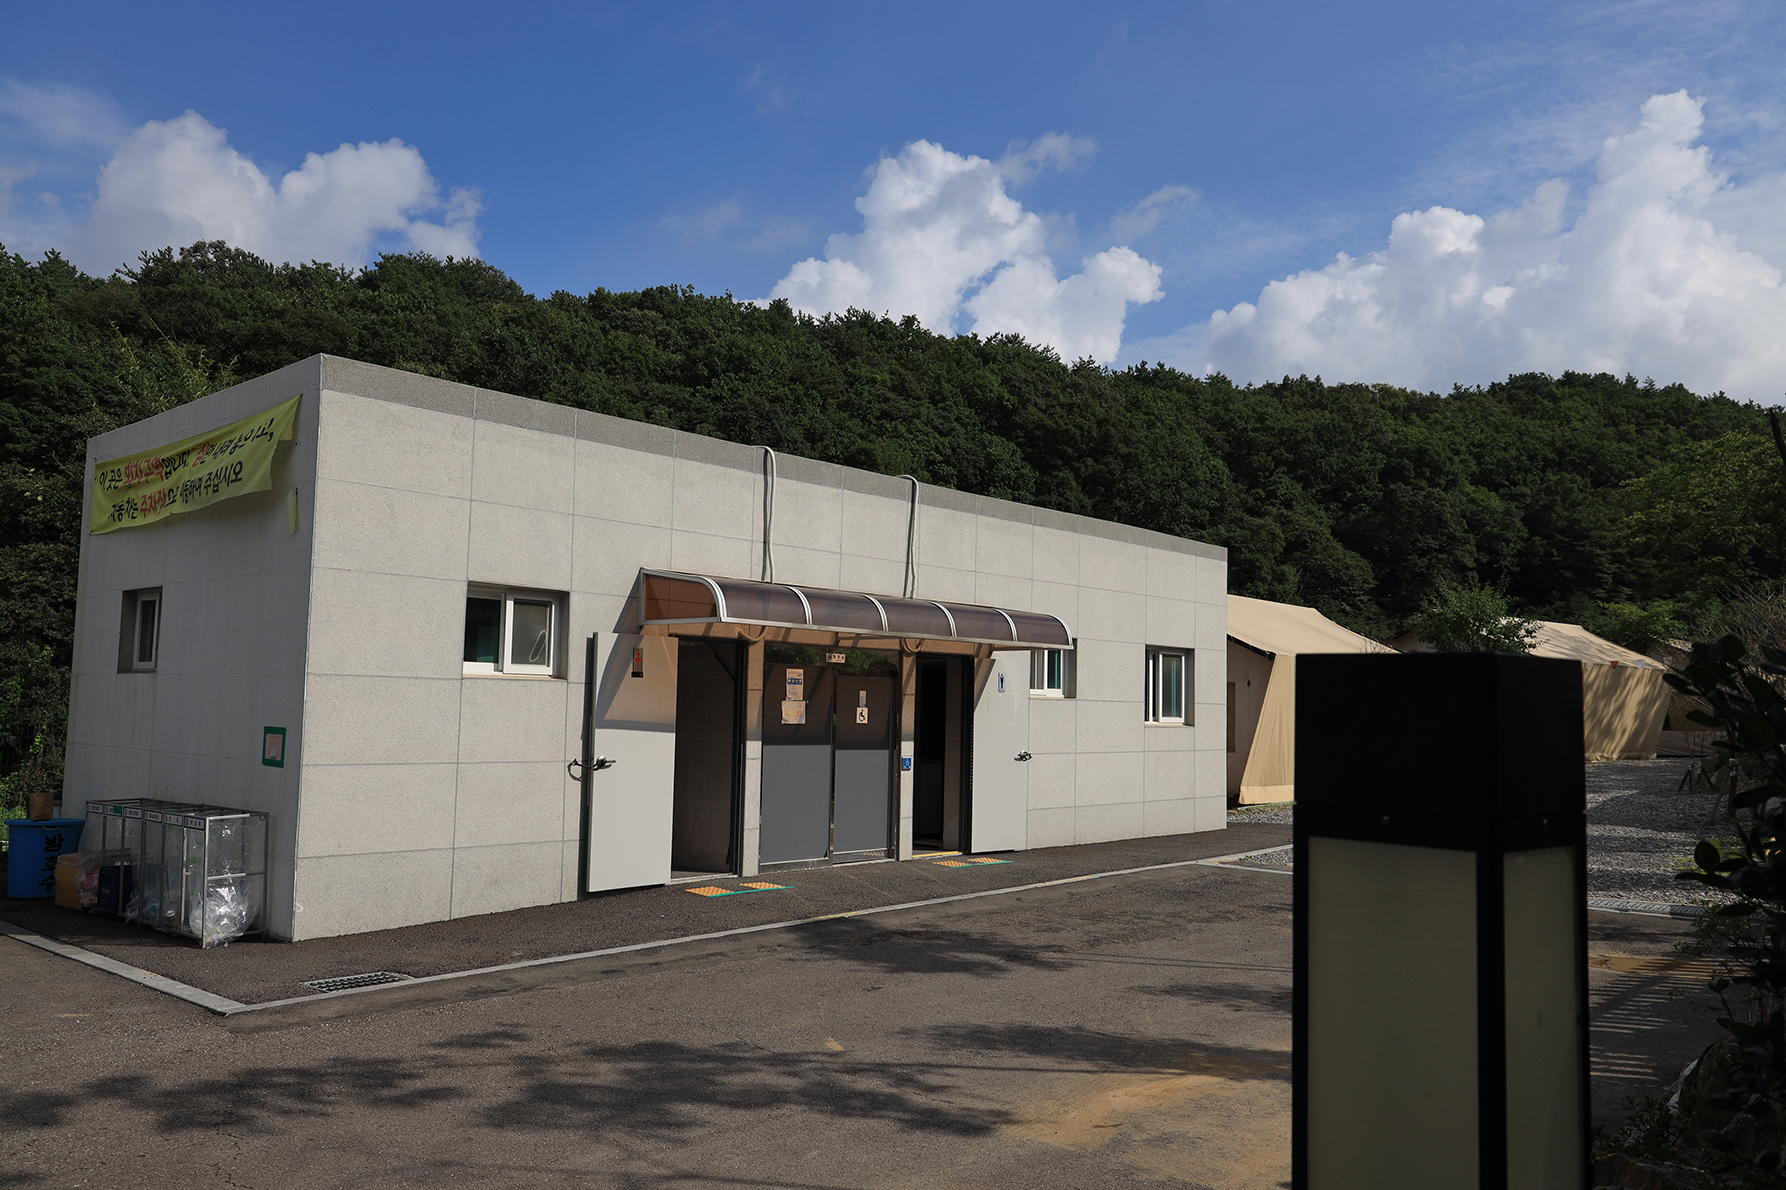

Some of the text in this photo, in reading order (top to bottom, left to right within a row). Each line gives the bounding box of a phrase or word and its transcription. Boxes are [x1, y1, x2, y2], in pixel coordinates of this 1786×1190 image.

[99, 467, 123, 491] 이곳은
[108, 497, 139, 523] 자동차는
[203, 460, 244, 496] 주십시오
